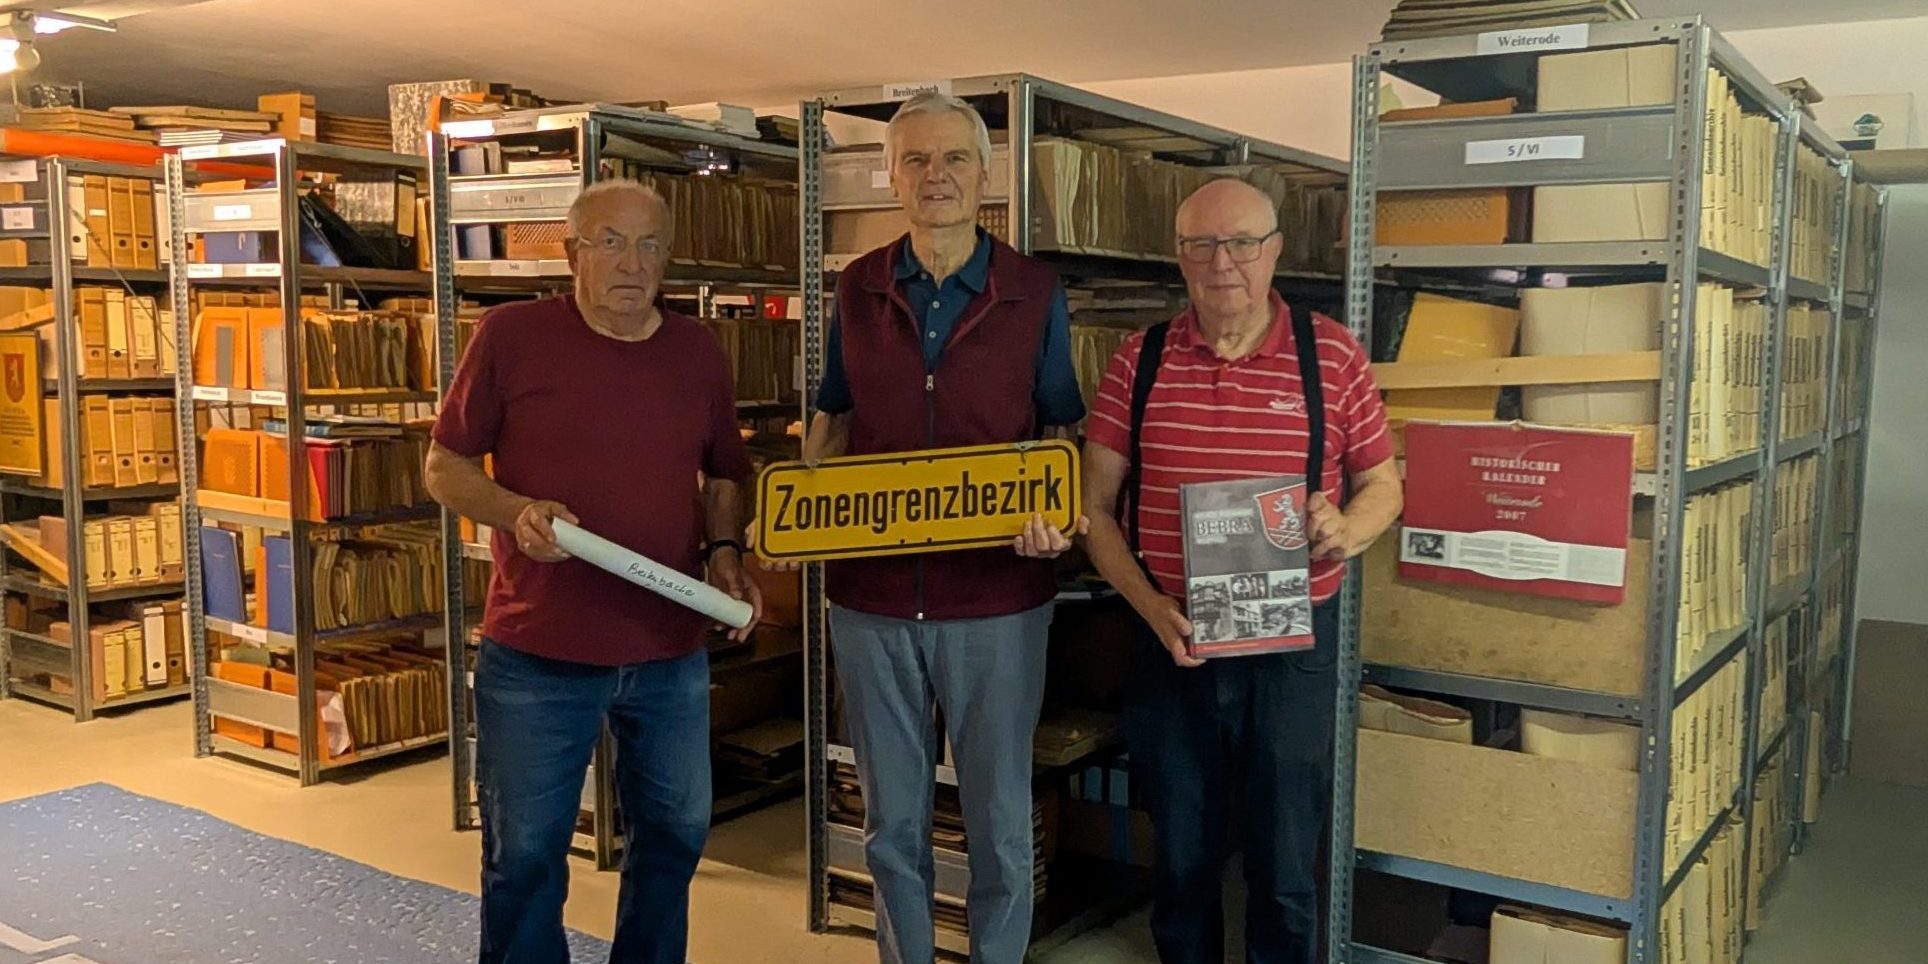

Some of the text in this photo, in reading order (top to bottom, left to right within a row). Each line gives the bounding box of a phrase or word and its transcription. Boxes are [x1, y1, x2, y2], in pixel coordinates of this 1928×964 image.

[1497, 33, 1561, 47] Weiterode
[1507, 144, 1540, 157] S / VI
[1470, 456, 1561, 472] HISTORISCHER
[1482, 471, 1547, 486] KALENDER
[773, 464, 1063, 534] Zonengrenzbezirk
[1495, 509, 1527, 521] 2007
[1197, 517, 1255, 536] BEBRA
